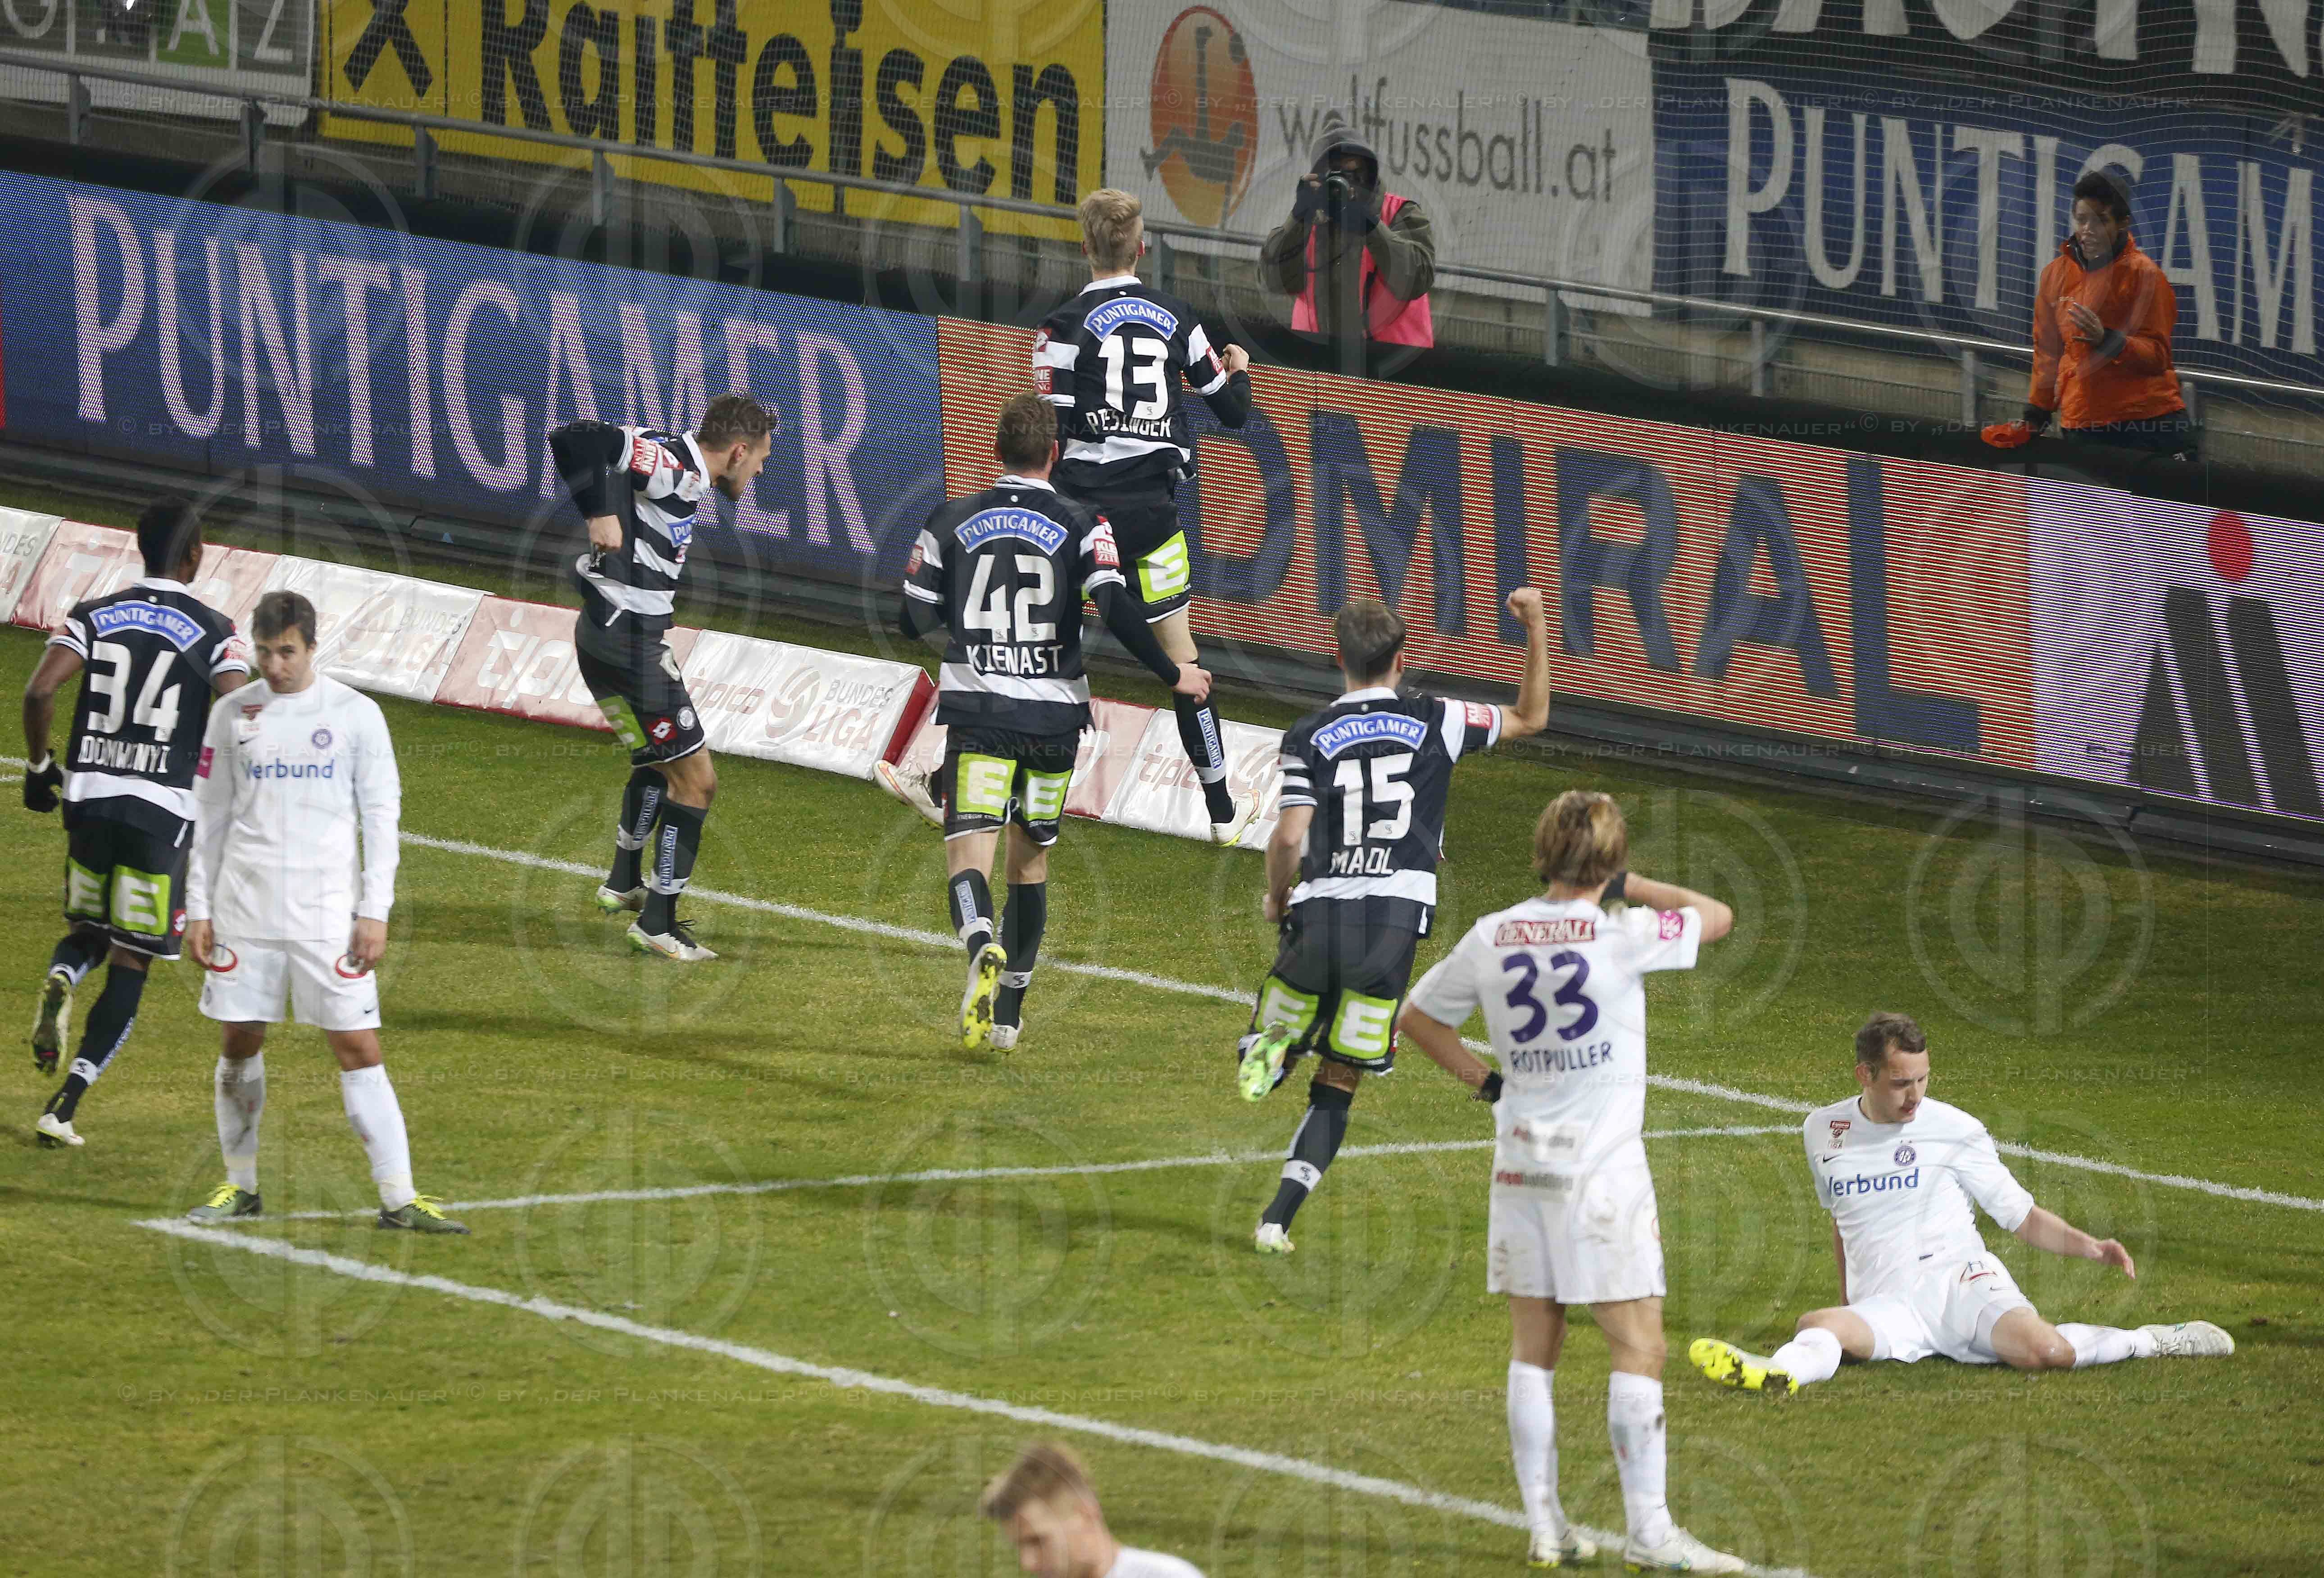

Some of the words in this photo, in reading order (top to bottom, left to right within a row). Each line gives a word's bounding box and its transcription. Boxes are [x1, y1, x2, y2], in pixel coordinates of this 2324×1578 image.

[1091, 303, 1172, 331] PUNTIGAMER
[1098, 334, 1169, 420] 13
[963, 515, 1059, 545] PUNTIGAMER
[962, 554, 1057, 643] 42
[98, 608, 195, 641] PUNTIGAMER
[965, 644, 1063, 675] KIENAST
[87, 640, 182, 742] 34
[825, 679, 895, 708] BUNDES
[803, 703, 880, 751] LIGA
[1318, 719, 1419, 749] PUNTIGAMER
[1333, 753, 1416, 846] 15
[1328, 846, 1394, 875] MADL
[1497, 920, 1593, 945] GENERALI
[1502, 951, 1598, 1044] 33
